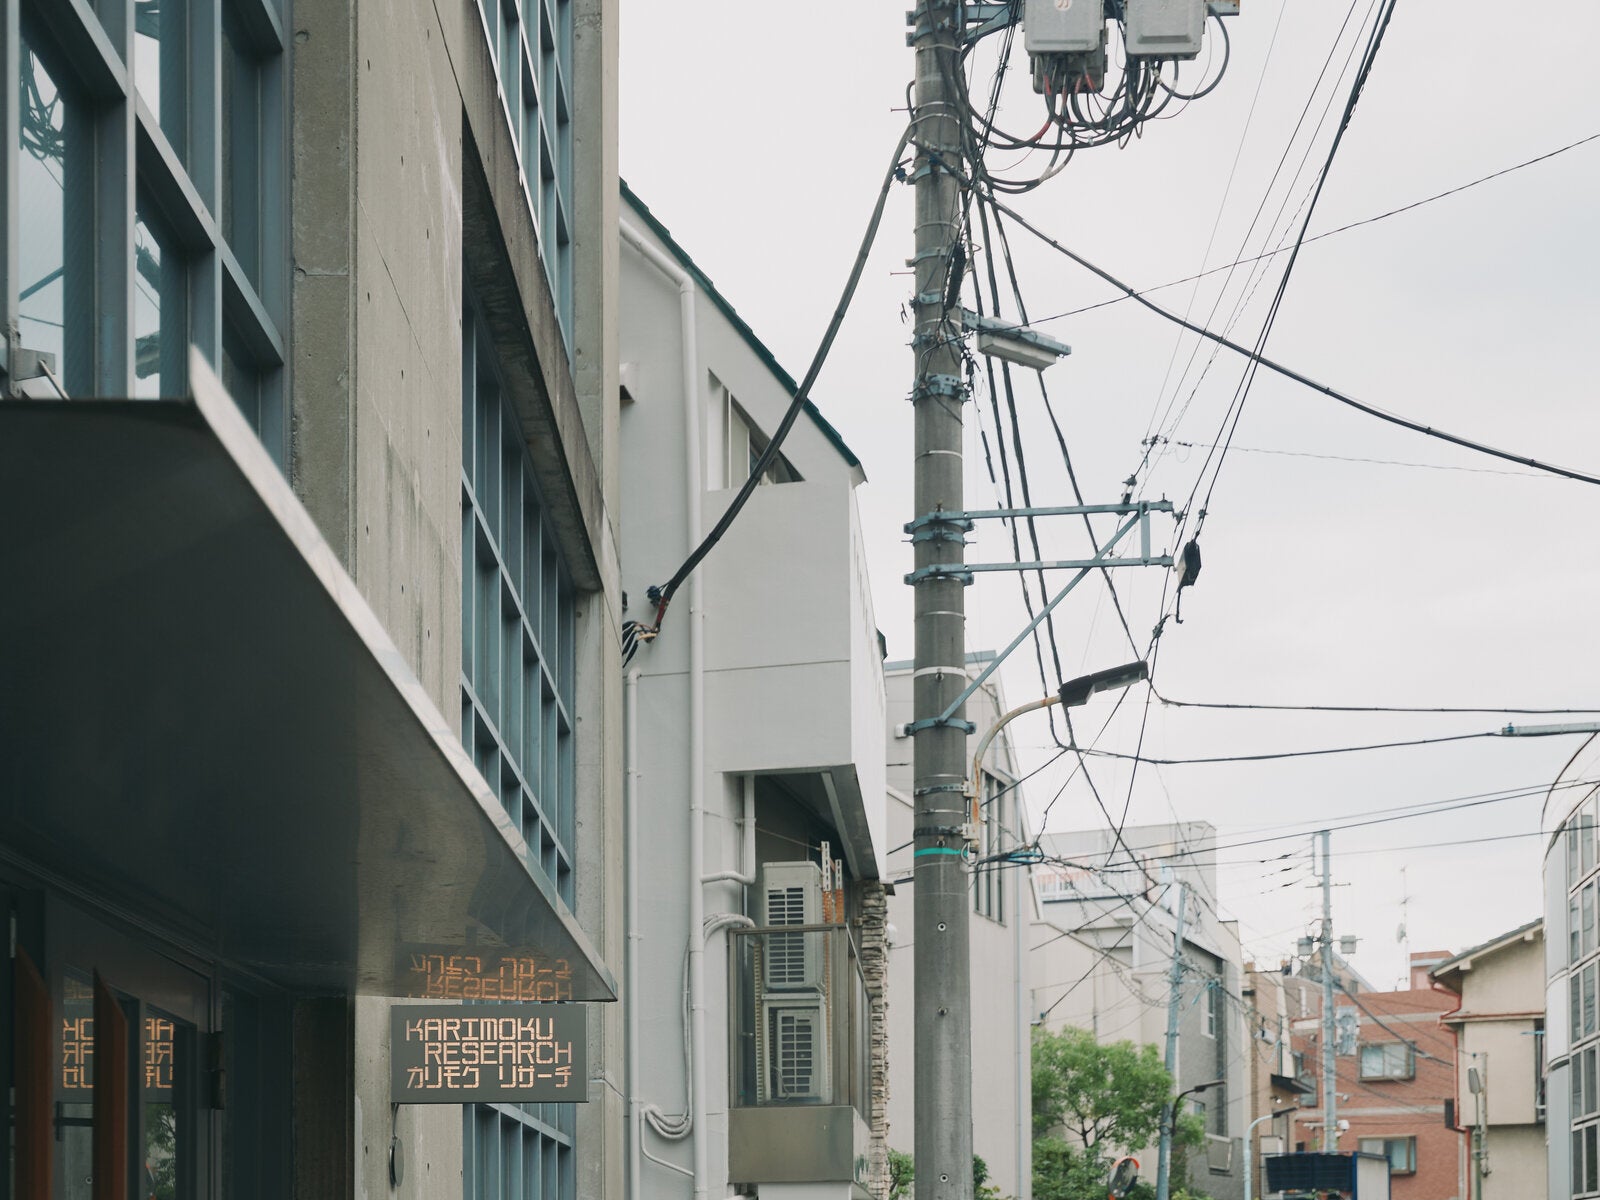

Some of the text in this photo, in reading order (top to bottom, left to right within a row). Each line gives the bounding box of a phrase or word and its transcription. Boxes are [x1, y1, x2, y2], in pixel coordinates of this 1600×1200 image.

[406, 1018, 554, 1041] KARIMOKU
[424, 1042, 572, 1065] RESEARCH
[406, 1065, 572, 1089] カリモク リサーチ
